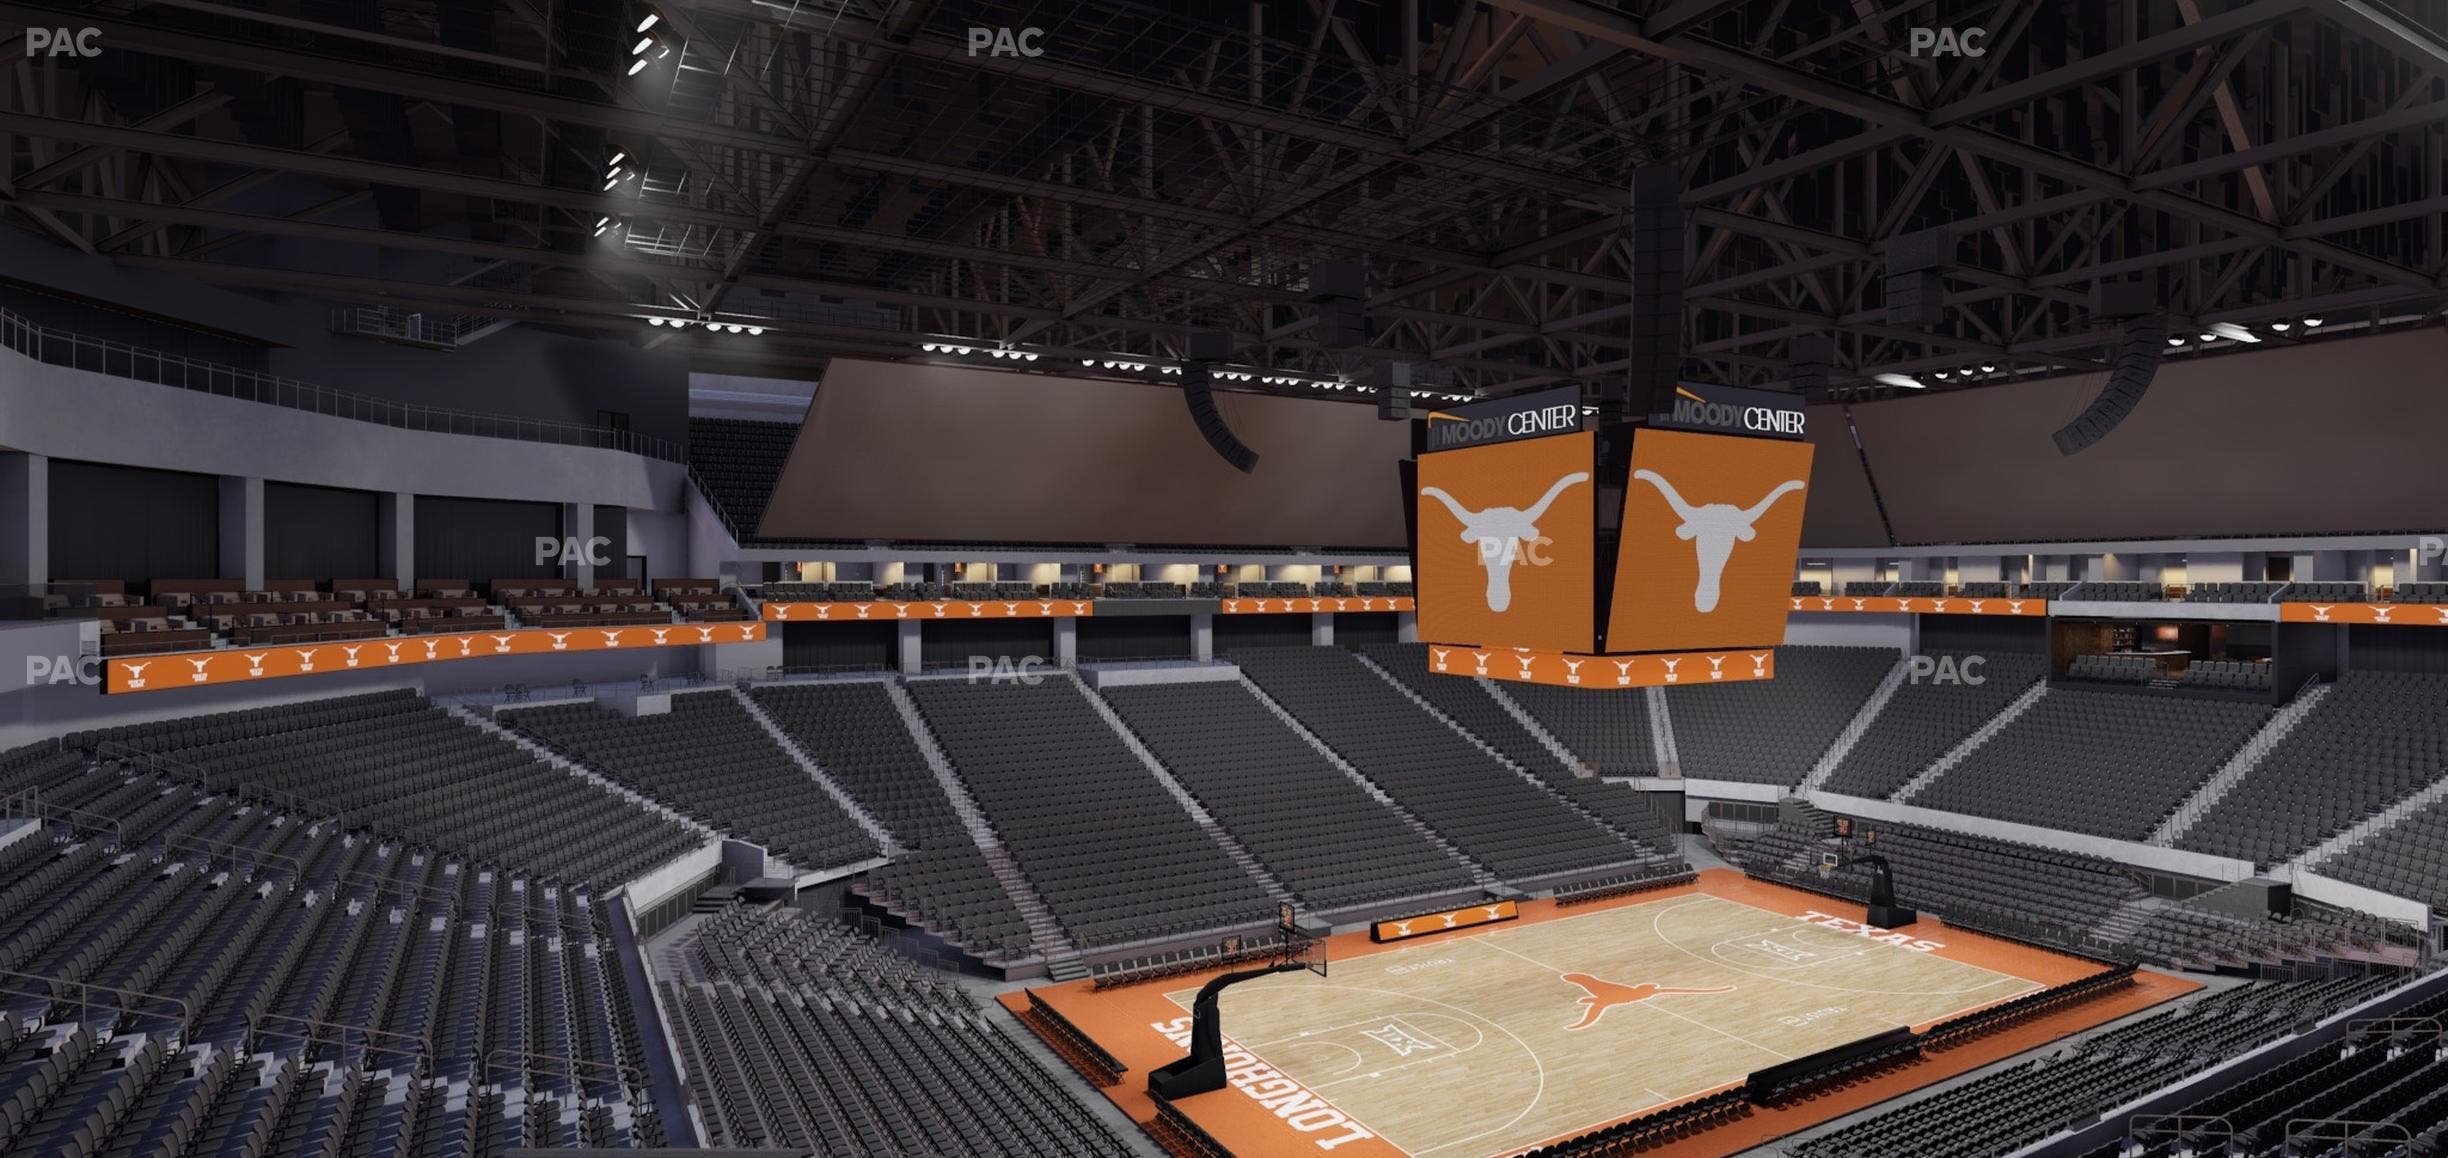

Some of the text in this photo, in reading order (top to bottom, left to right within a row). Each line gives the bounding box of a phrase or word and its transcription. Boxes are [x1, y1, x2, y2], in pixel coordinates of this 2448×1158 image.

[1442, 404, 1577, 445] MOODY CENTER
[1672, 399, 1805, 434] MOODY CENTER
[1796, 910, 1946, 952] TEXAS
